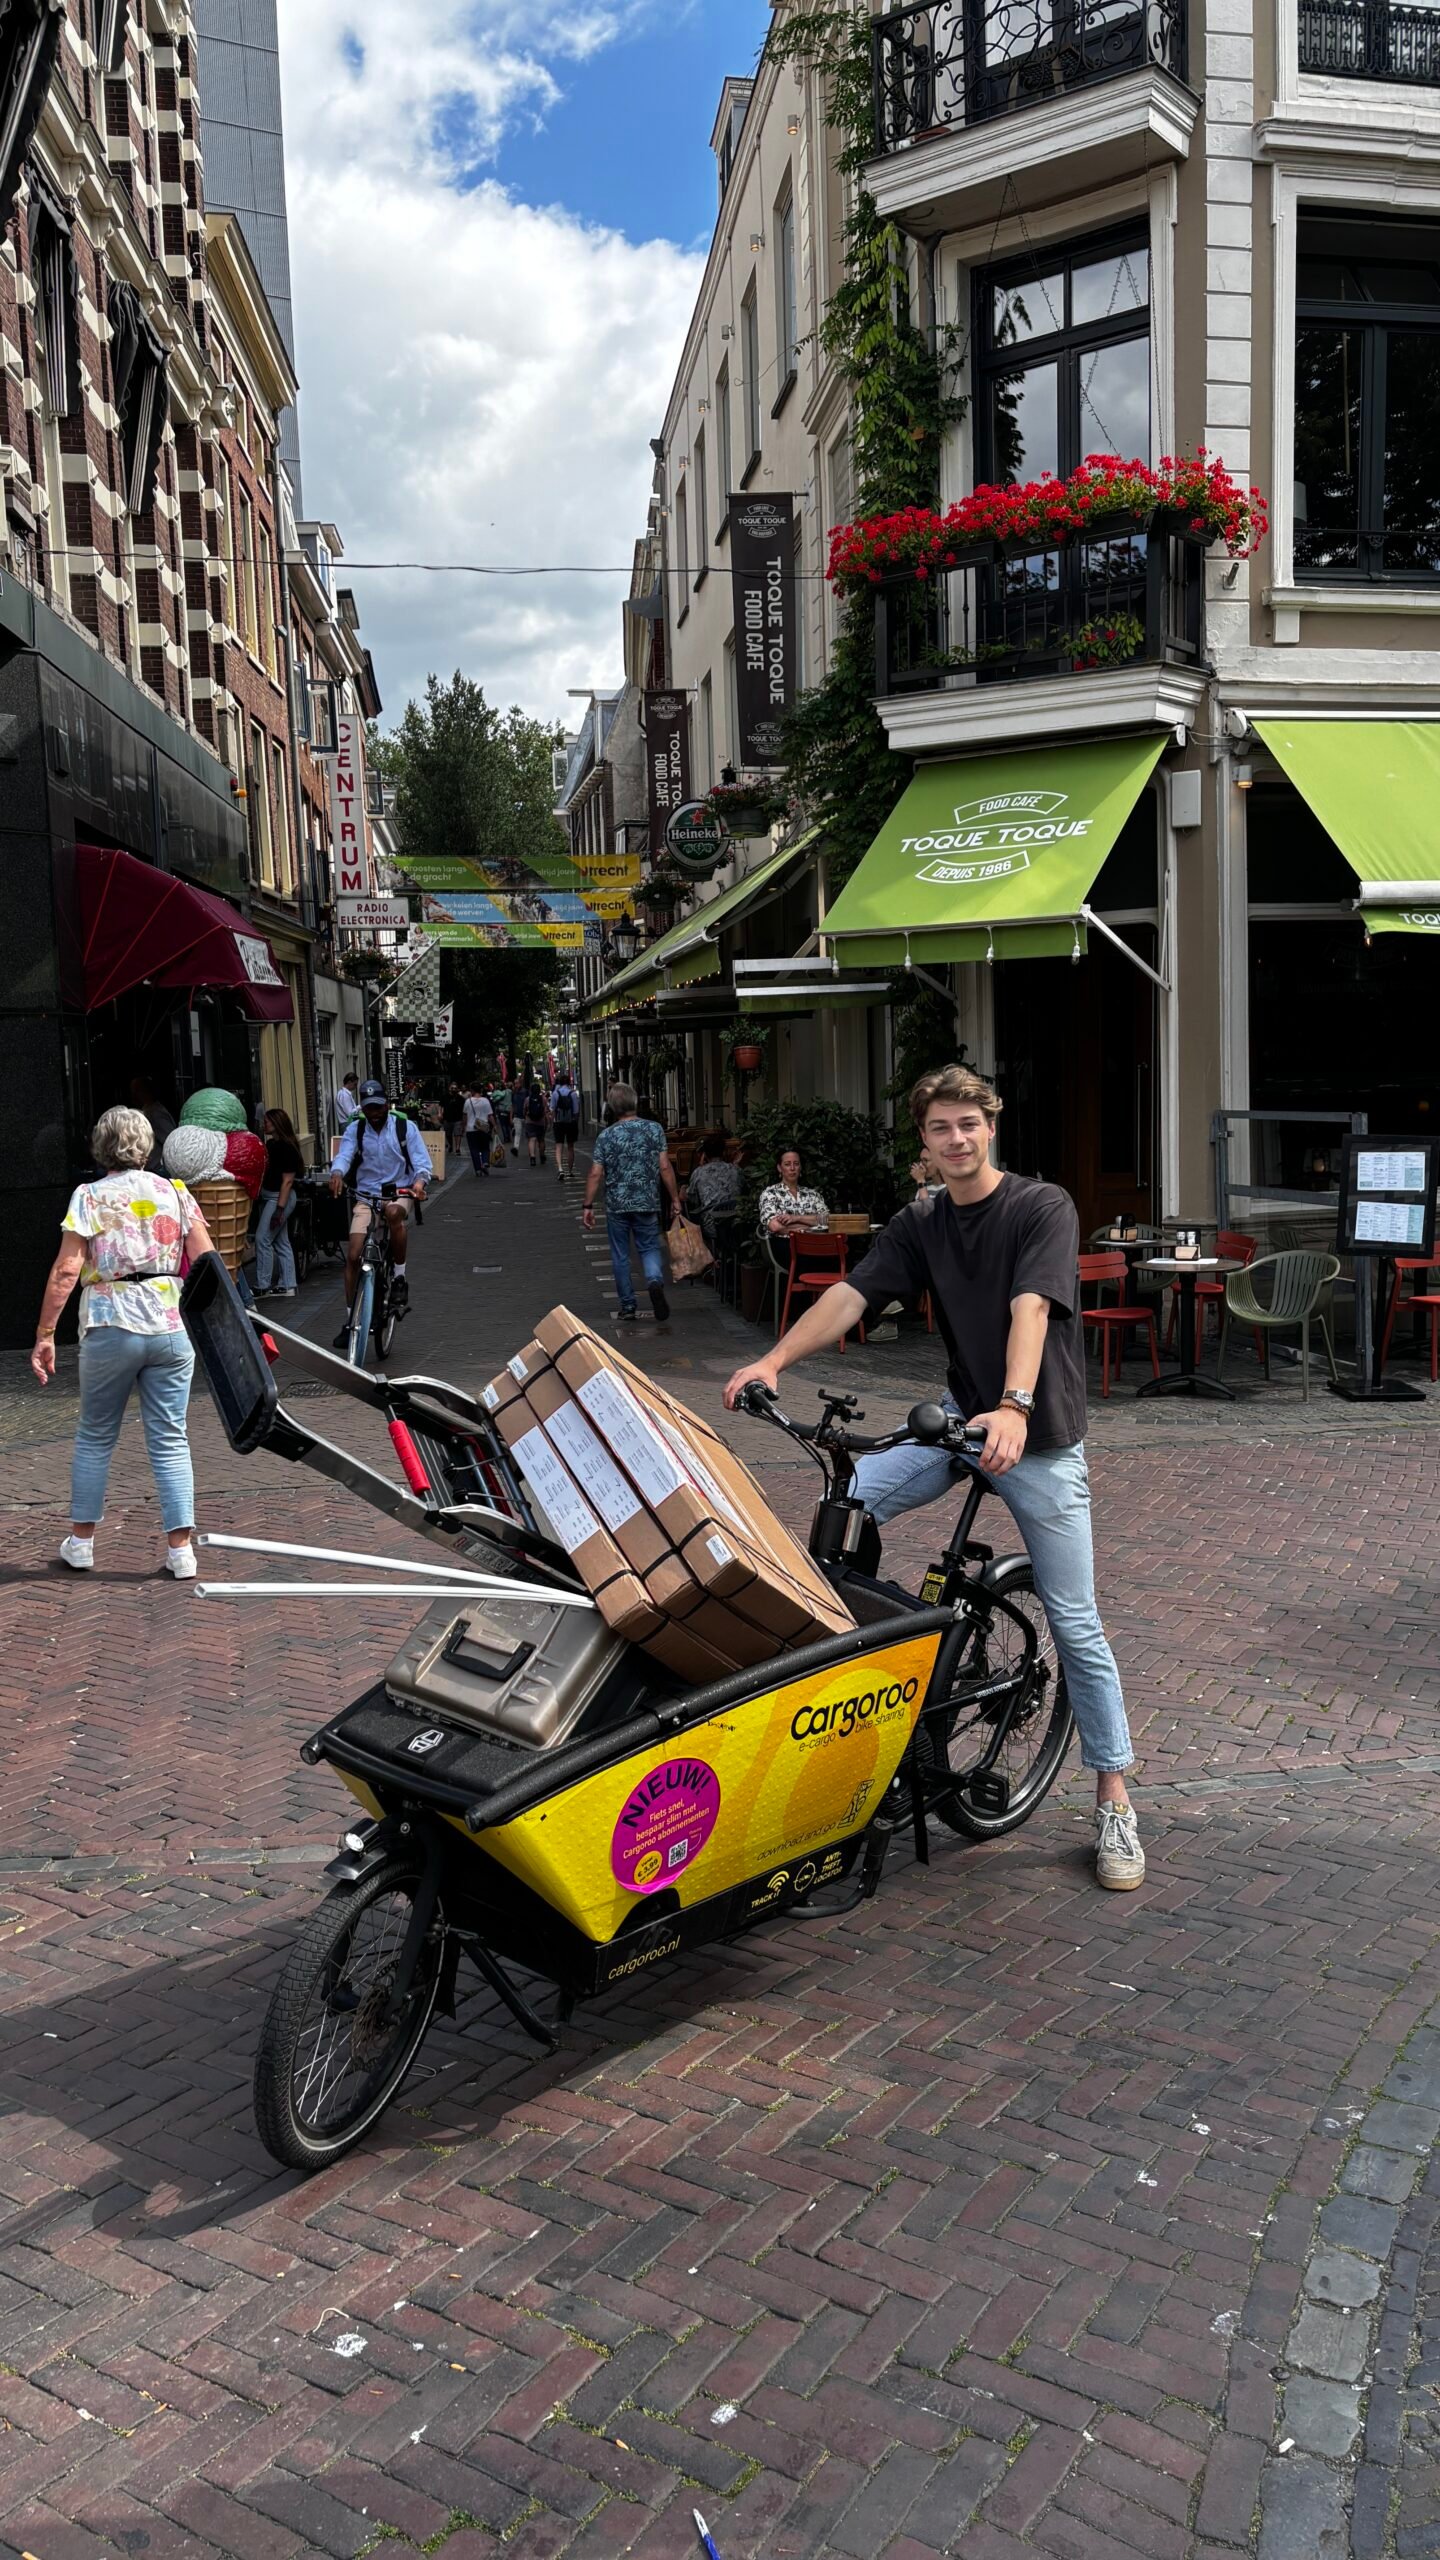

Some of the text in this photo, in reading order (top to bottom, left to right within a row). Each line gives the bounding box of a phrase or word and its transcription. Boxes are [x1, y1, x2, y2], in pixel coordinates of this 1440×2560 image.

[763, 516, 787, 525] TOQUE
[766, 555, 783, 628] TOQUE
[744, 590, 765, 671] FOOD CAFE
[768, 633, 785, 705] TOQUE
[669, 730, 682, 778] TOQUE
[654, 753, 669, 807] FOOD CAFE
[336, 722, 362, 890] CENTRUM
[979, 794, 1043, 813] FOOD CAFÉ
[671, 828, 718, 840] Heineke
[901, 819, 1094, 853] TOQUE TOQUE
[410, 872, 452, 883] de gracht
[442, 864, 468, 875] langs
[932, 860, 1012, 880] DEPUIS 1986
[340, 915, 406, 926] ELECTRONICA
[356, 903, 389, 913] RADIO
[386, 1051, 399, 1101] frietwinkel
[790, 1676, 919, 1741] Cargoroo
[799, 1707, 905, 1752] e-cargo bike sharing
[621, 1762, 712, 1829] NIEUW!
[649, 1797, 685, 1823] Fiets snel,
[623, 1836, 657, 1860] Cargoroo
[657, 1807, 710, 1841] abonnementen
[635, 1801, 697, 1842] bespaar slim met
[822, 1858, 842, 1873] THEFT
[823, 1851, 842, 1864] ANTI-
[813, 1865, 844, 1885] LOCATOR
[751, 1892, 774, 1909] TRACK
[608, 1934, 681, 1980] cargoroo.nl
